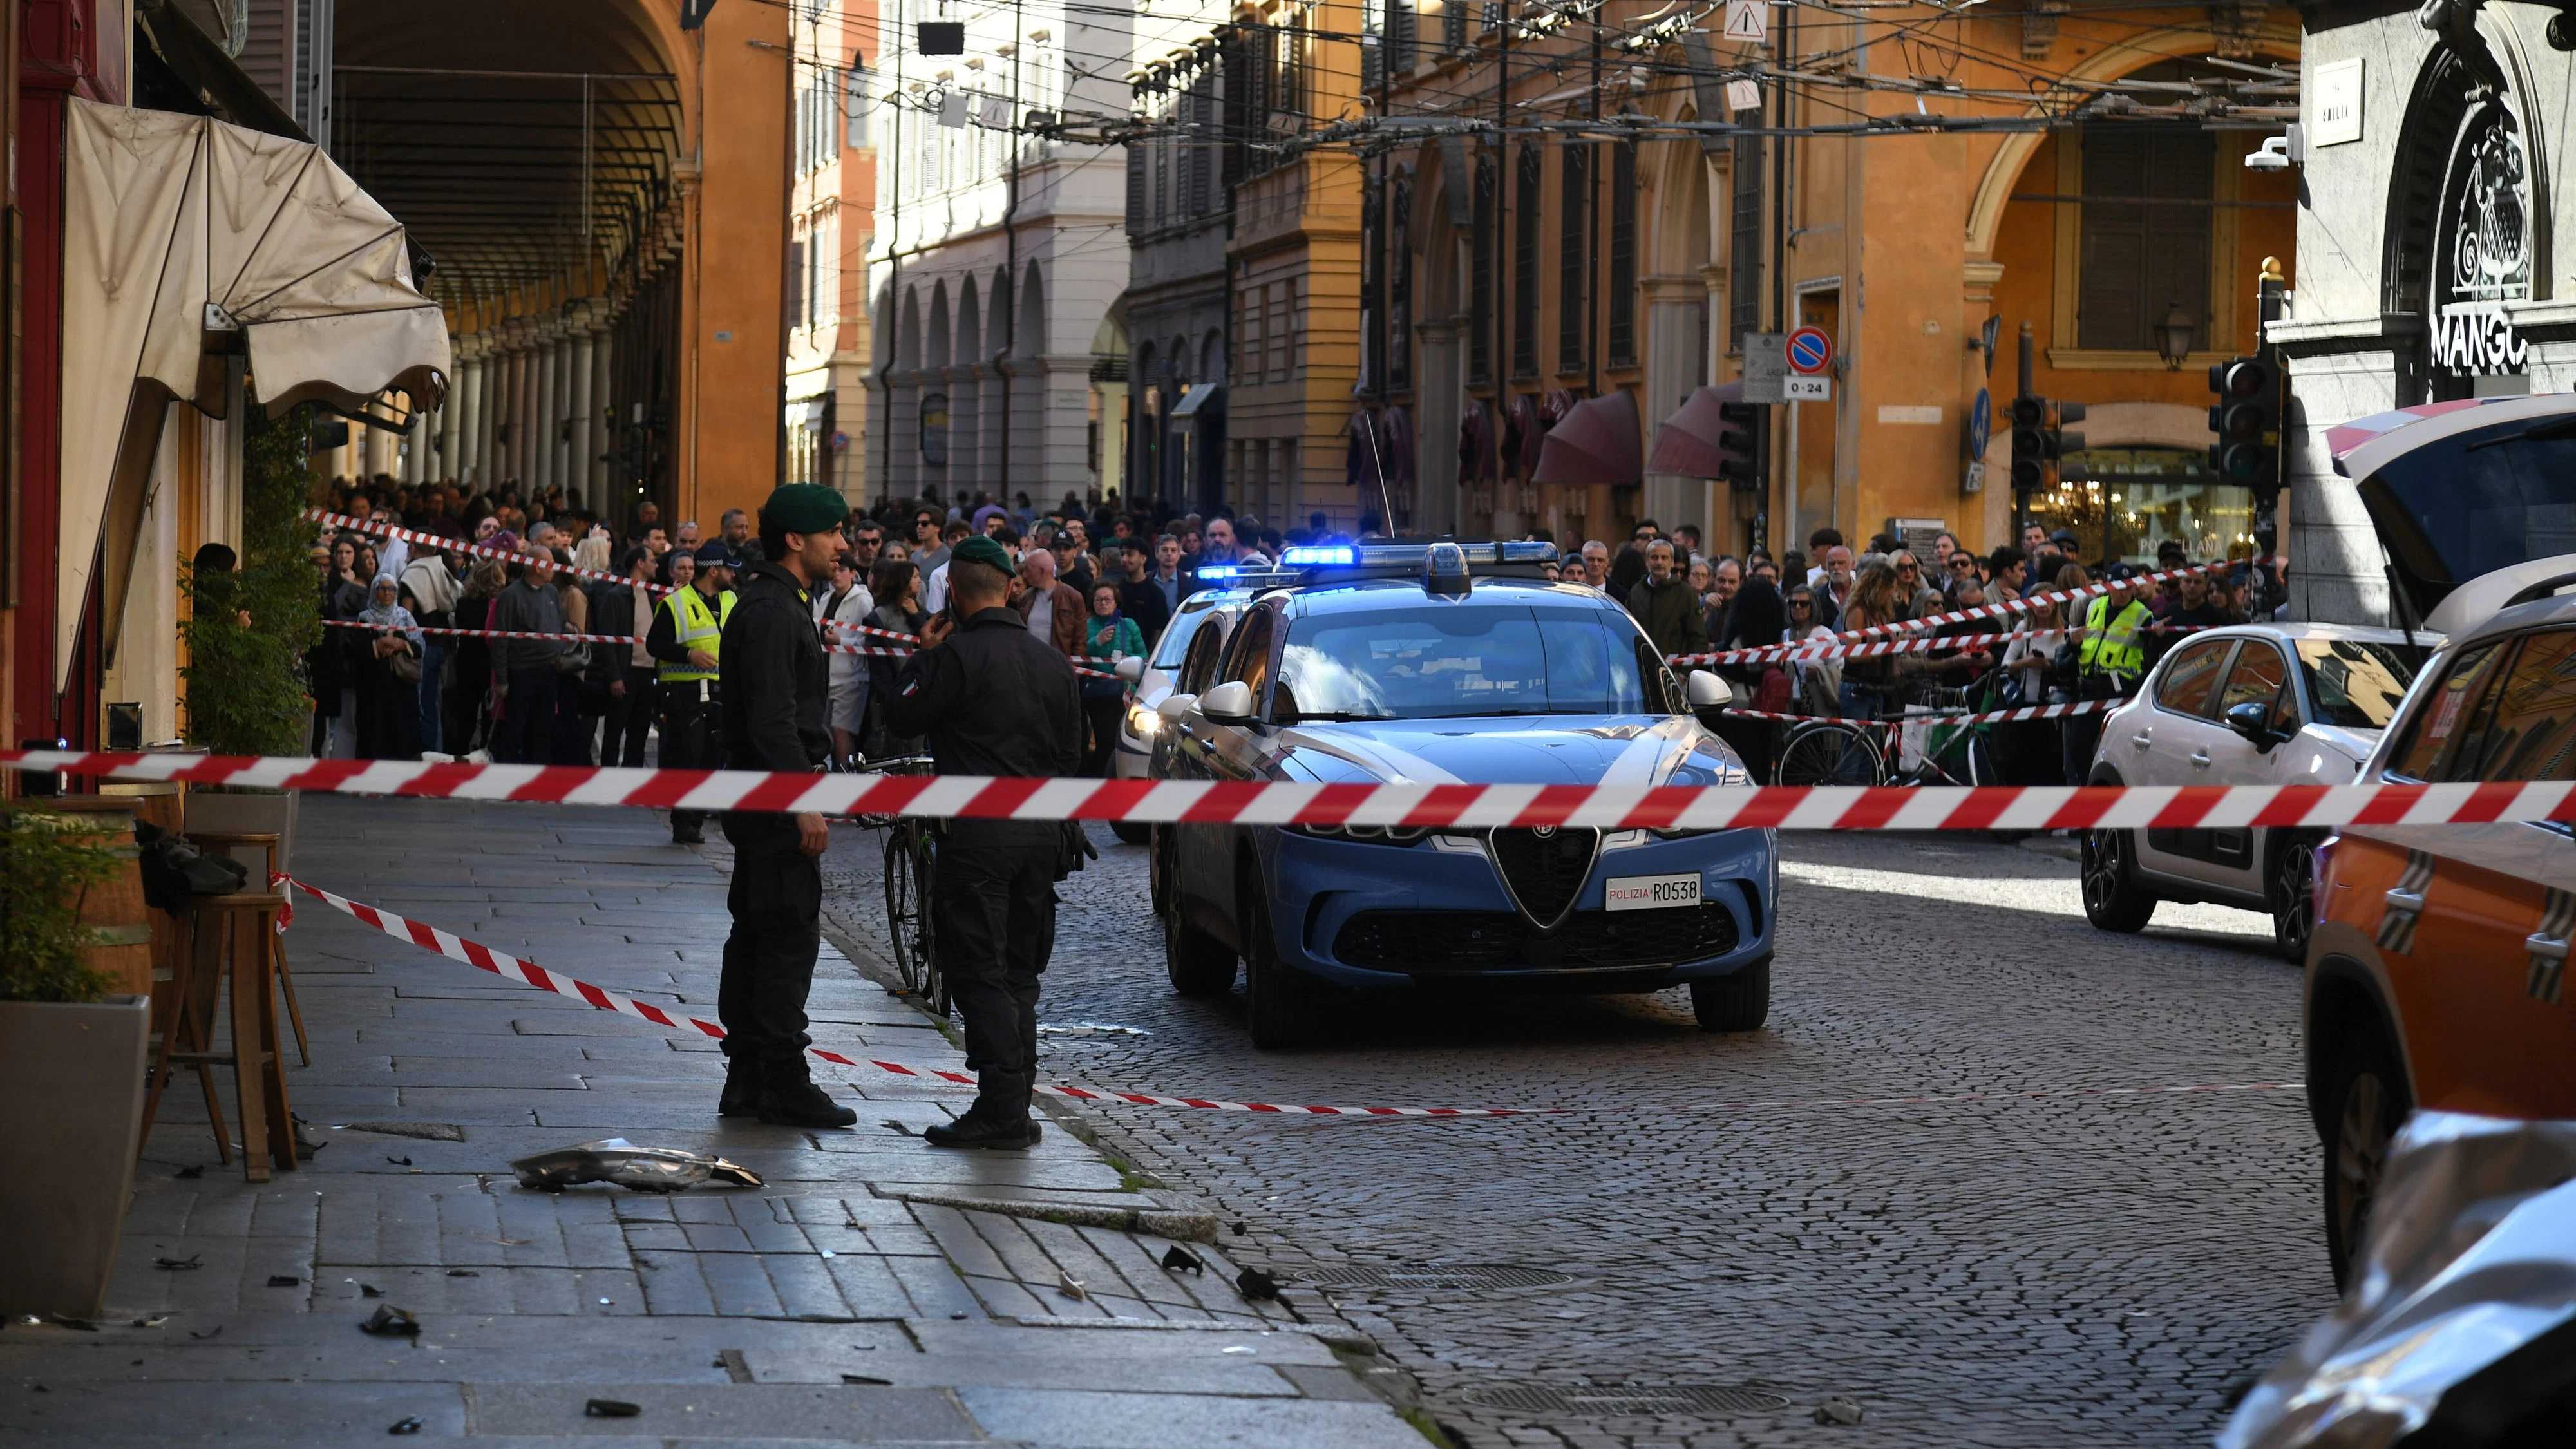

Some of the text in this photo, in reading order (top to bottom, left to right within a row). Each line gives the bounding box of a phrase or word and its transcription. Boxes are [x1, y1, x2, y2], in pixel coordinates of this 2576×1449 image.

[2322, 105, 2348, 122] EMILIA
[2140, 538, 2222, 554] POLLANA
[1609, 880, 1698, 902] POLIZIA R0538
